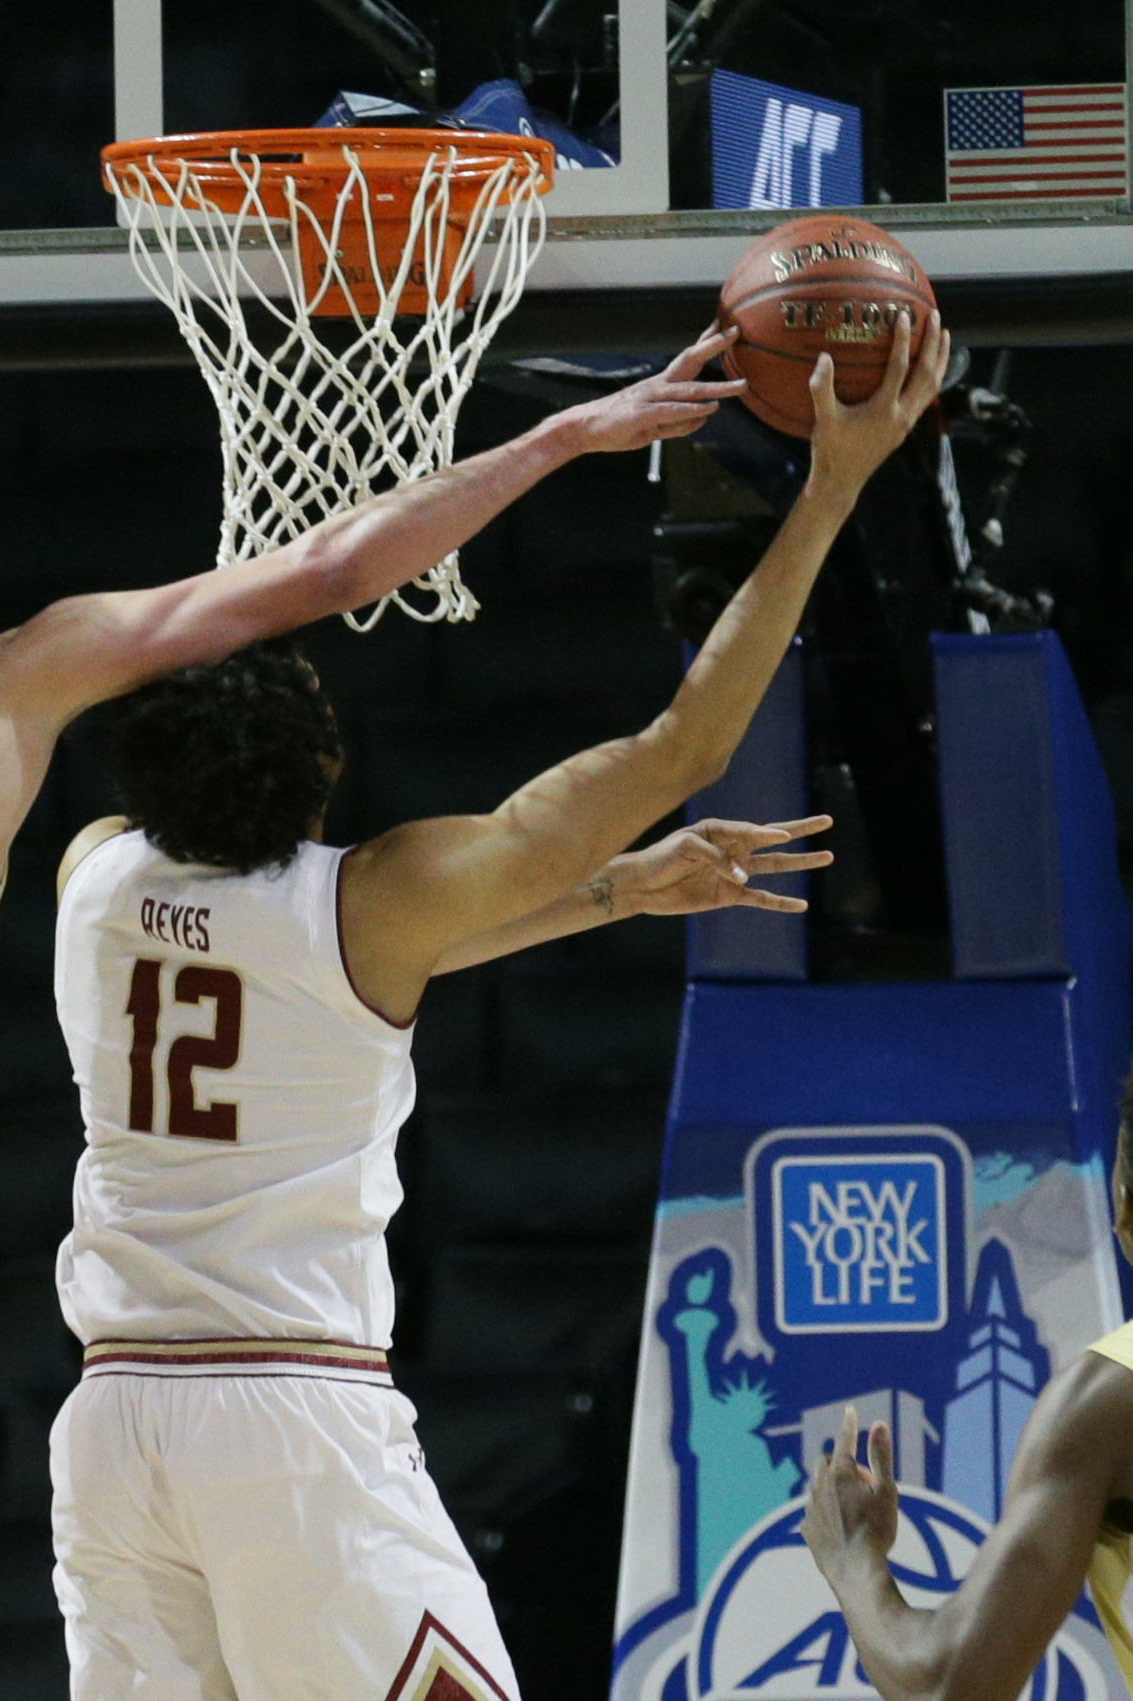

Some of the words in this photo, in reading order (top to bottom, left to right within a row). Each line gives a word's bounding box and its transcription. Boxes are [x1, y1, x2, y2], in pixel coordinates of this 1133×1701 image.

[141, 897, 211, 952] REYES
[125, 957, 242, 1143] 12
[808, 1180, 918, 1225] NEW
[789, 1217, 932, 1268] YORK
[811, 1262, 917, 1306] LIFE
